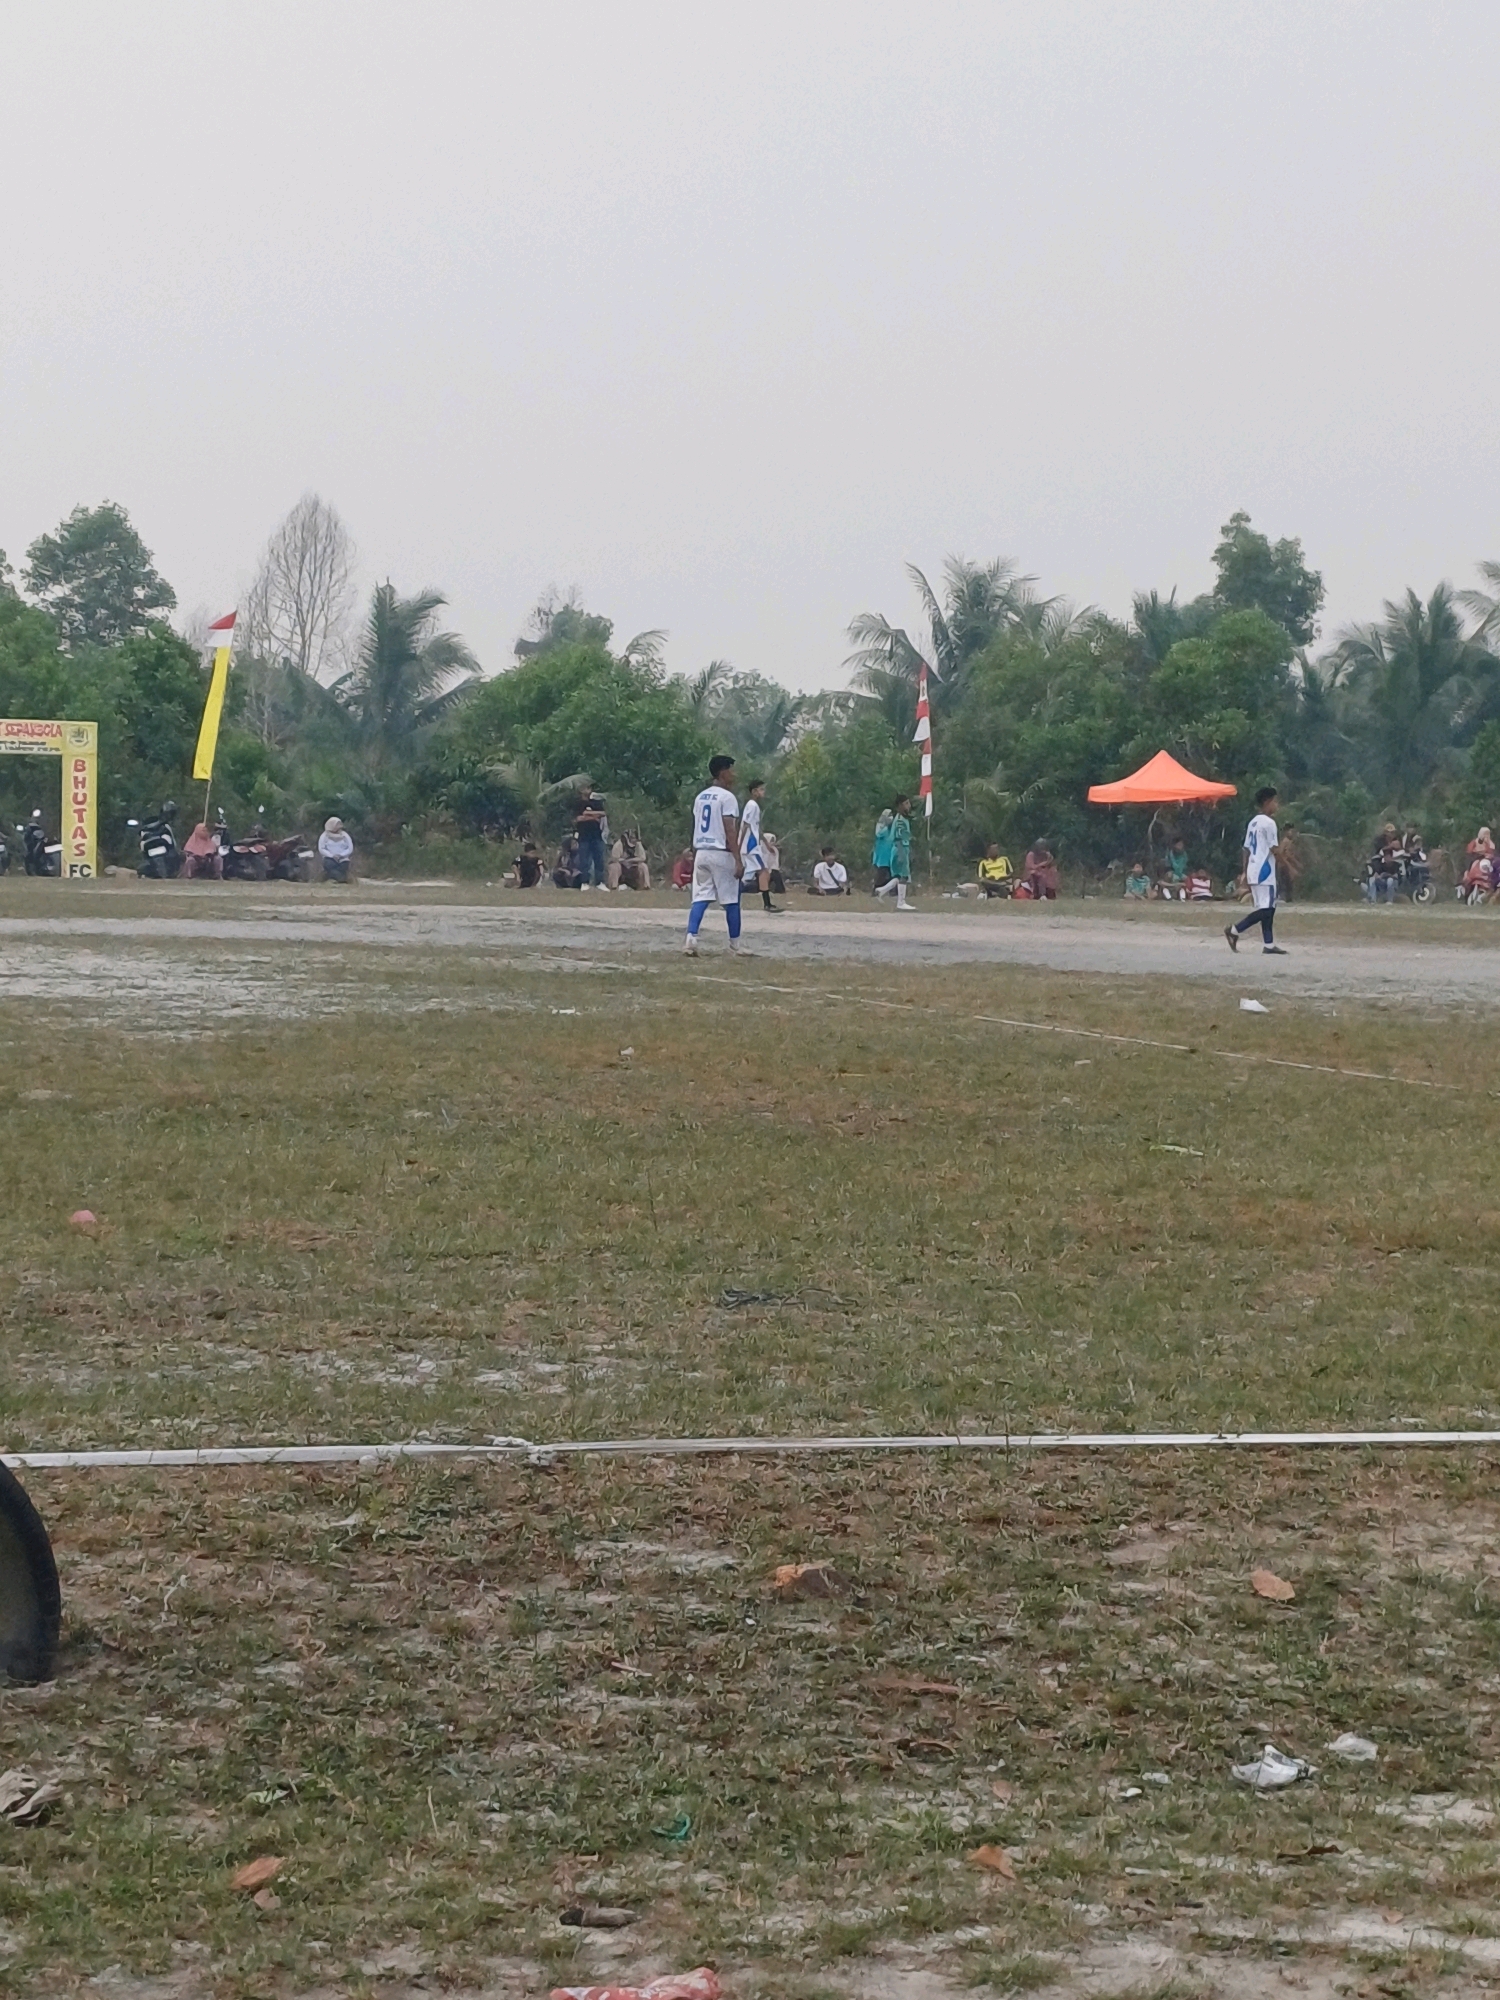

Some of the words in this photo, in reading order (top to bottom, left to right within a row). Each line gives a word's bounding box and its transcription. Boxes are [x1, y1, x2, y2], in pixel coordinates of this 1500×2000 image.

[72, 758, 88, 857] BHUTAS
[700, 804, 711, 833] 9
[69, 863, 92, 877] FC
